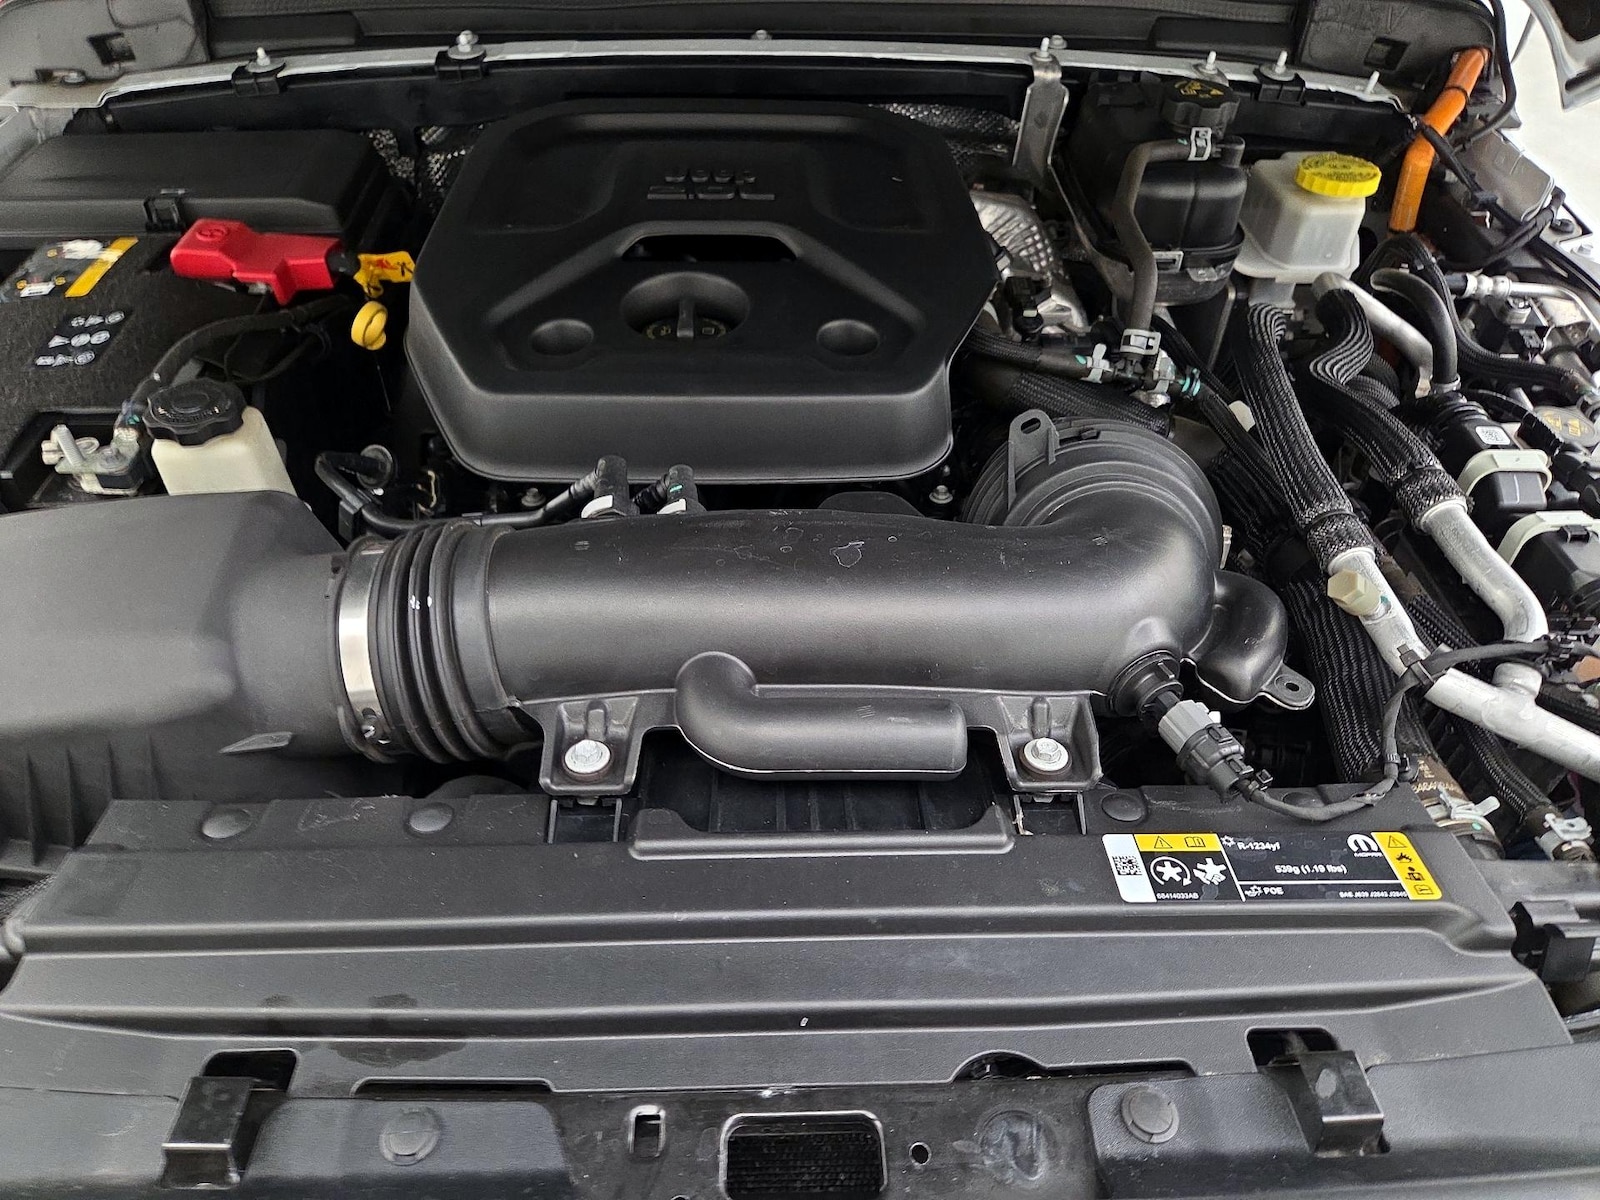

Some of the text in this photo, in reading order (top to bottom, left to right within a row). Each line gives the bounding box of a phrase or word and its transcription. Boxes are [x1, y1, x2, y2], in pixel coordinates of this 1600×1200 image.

[1274, 863, 1348, 875] 539g (1.19 lbs)
[1263, 886, 1284, 895] POE
